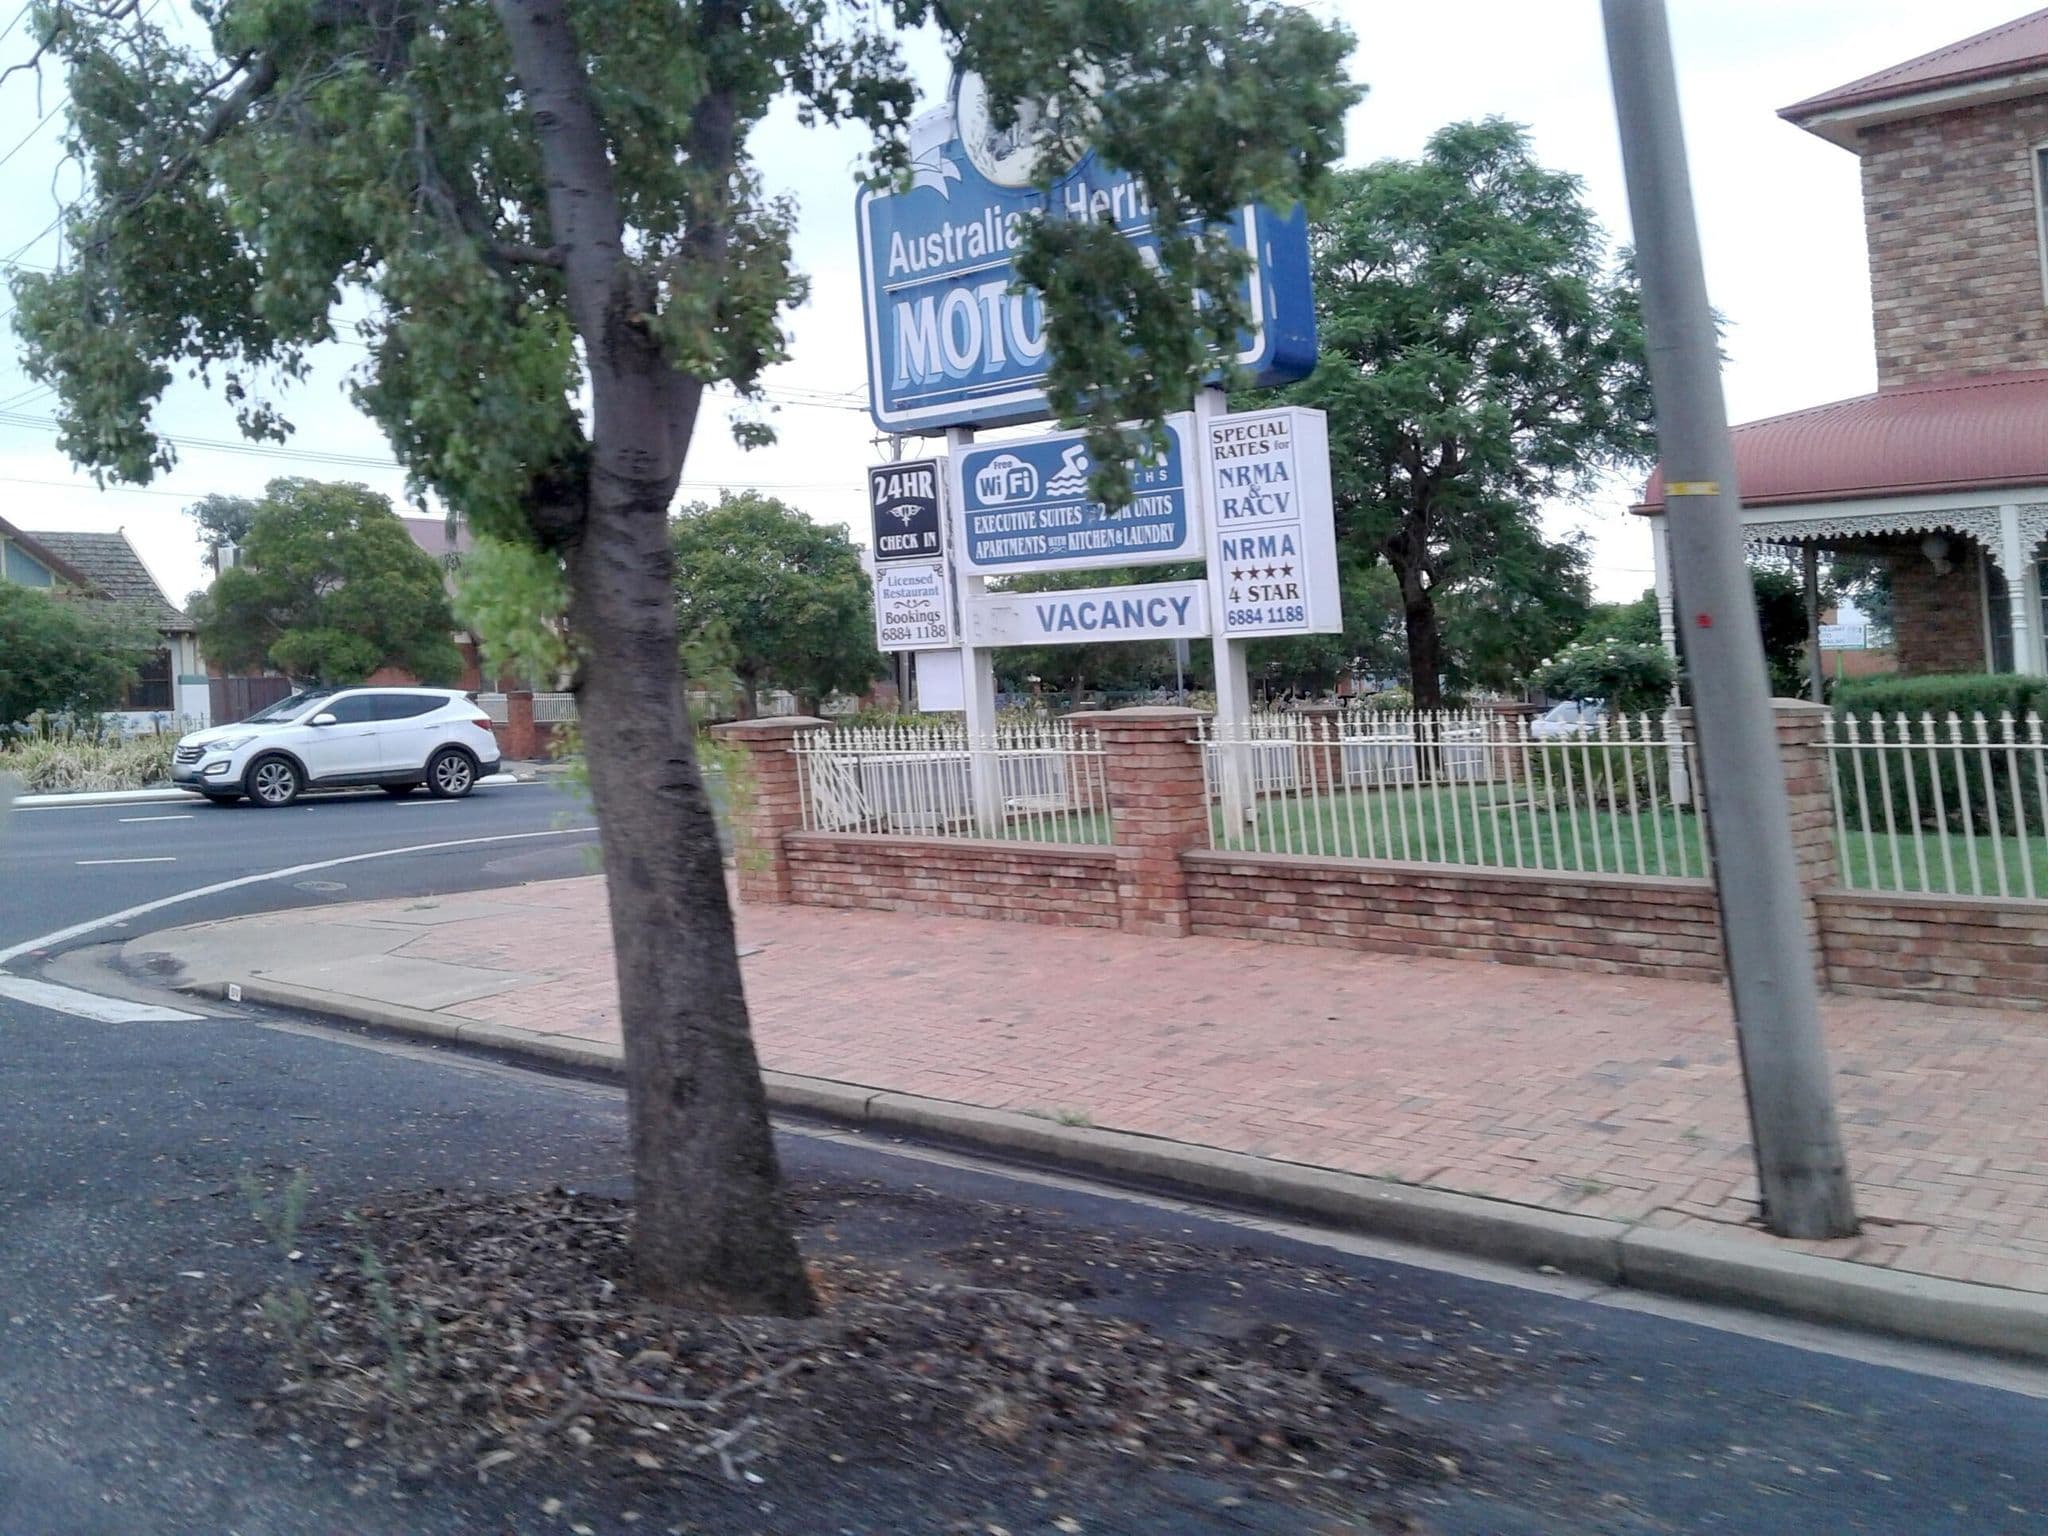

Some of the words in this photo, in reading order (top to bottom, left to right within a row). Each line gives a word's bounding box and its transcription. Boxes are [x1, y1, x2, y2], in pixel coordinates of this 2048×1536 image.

[893, 279, 1054, 390] MOTO
[1213, 421, 1288, 444] SPECIAL
[1215, 440, 1270, 460] RATES
[1274, 440, 1289, 450] for
[993, 461, 1013, 470] Free
[1219, 461, 1289, 489] NRMA
[874, 470, 935, 506] 24HR
[1248, 484, 1261, 499] &
[974, 511, 1037, 534] EXECUTIVE
[1039, 506, 1083, 528] SUITES
[1134, 495, 1174, 518] UNITS
[1222, 492, 1290, 519] RACV
[880, 533, 919, 551] CHECK
[923, 532, 937, 547] IN
[976, 535, 1046, 559] APARTMENTS
[1068, 529, 1116, 551] KITCHEN
[1123, 523, 1175, 546] LAUNDRY
[1222, 534, 1296, 561] NRMA
[888, 573, 934, 587] Licensed
[883, 586, 939, 599] Restaurant
[1228, 587, 1241, 603] 4
[1247, 583, 1300, 602] STAR
[885, 609, 941, 625] Bookings
[1036, 596, 1191, 632] VACANCY
[1228, 607, 1263, 626] 6884
[1267, 605, 1304, 623] 1188
[883, 627, 912, 641] 6884
[917, 624, 945, 638] 1188
